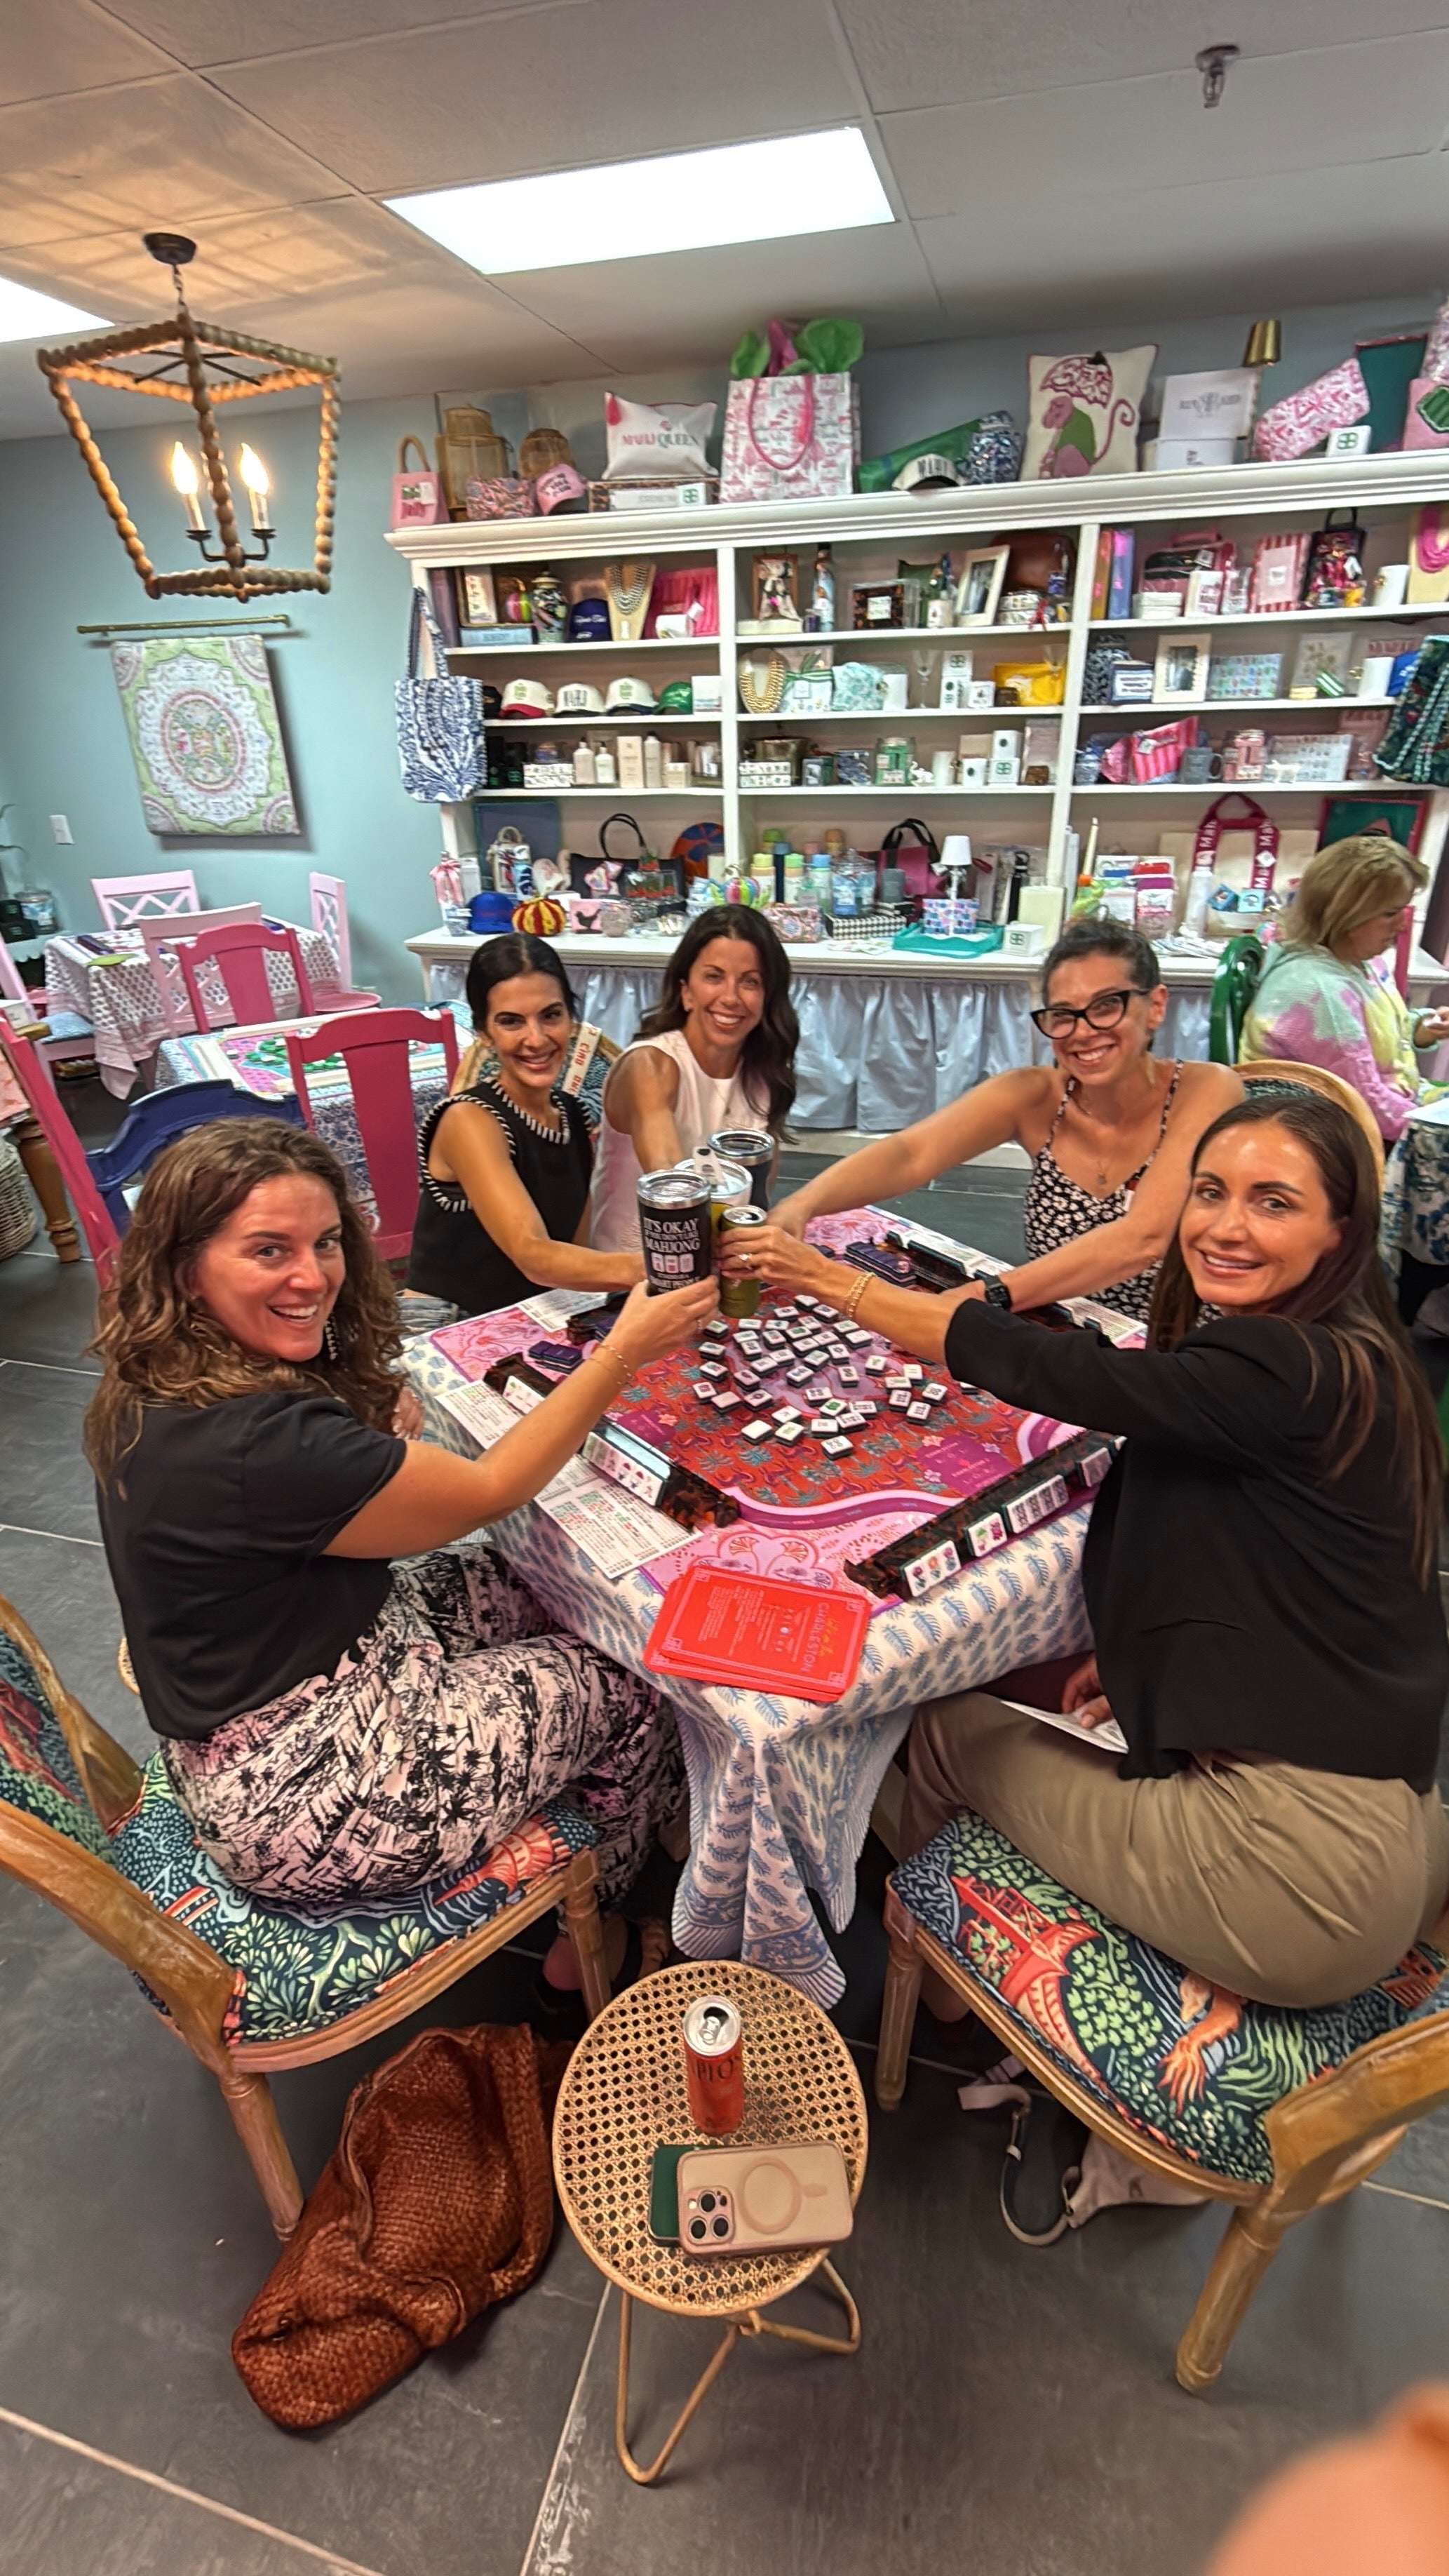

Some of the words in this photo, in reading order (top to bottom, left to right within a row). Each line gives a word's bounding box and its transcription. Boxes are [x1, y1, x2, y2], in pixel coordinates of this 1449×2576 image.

[662, 1218, 699, 1234] OKAY
[645, 1237, 701, 1254] MAHJONG
[800, 1602, 830, 1672] CHARLESTON
